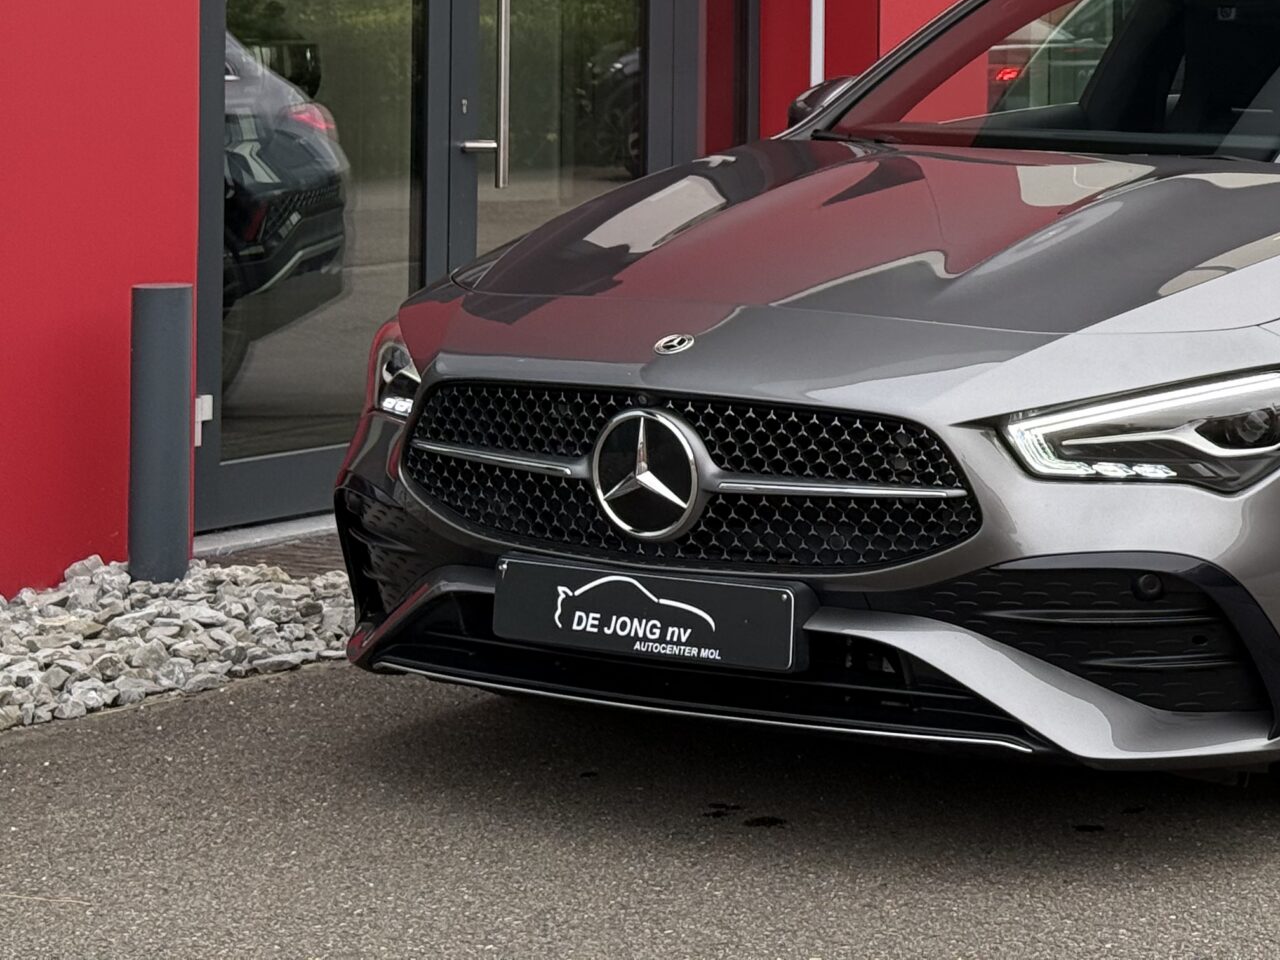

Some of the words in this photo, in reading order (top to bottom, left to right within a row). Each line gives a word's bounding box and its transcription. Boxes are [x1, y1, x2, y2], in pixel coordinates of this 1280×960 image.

[572, 611, 600, 633] DE
[604, 615, 662, 639] JONG
[666, 625, 692, 643] nv
[633, 641, 698, 658] AUTOCENTER
[700, 648, 721, 660] MOL
